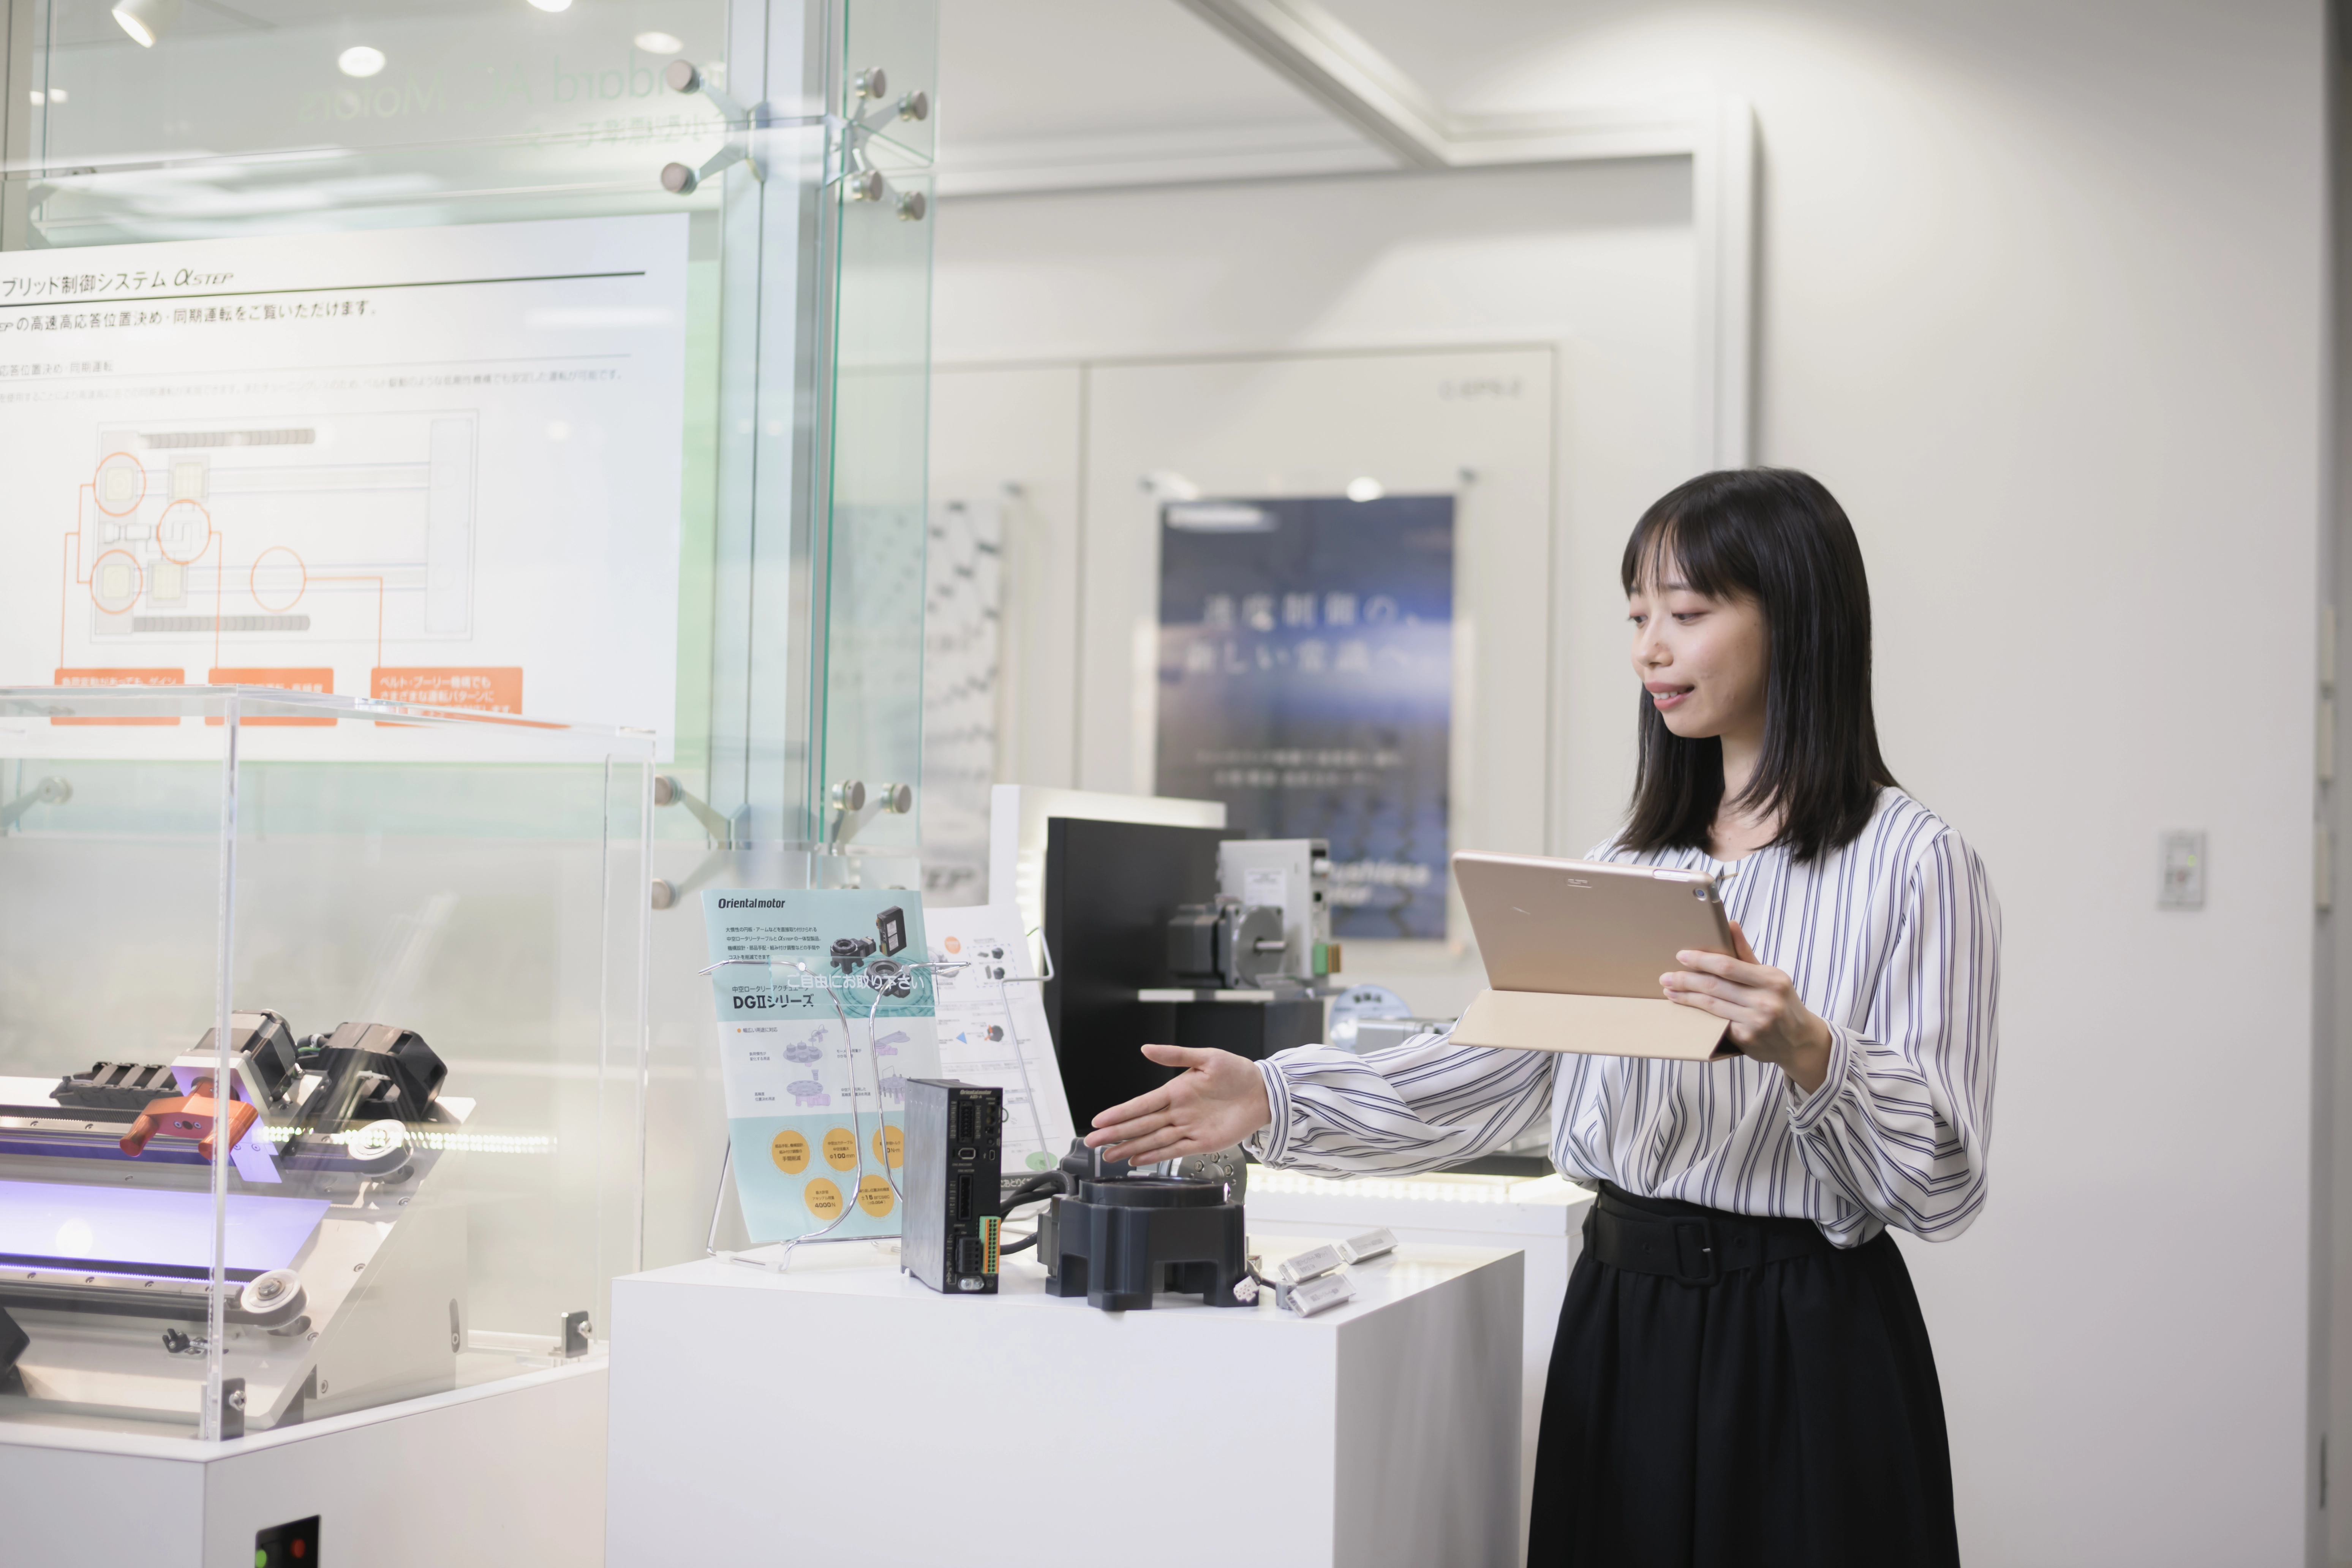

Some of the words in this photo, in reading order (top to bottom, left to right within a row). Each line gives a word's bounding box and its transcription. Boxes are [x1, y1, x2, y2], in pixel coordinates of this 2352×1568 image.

[787, 973, 924, 990] ご自由にお取り下さい
